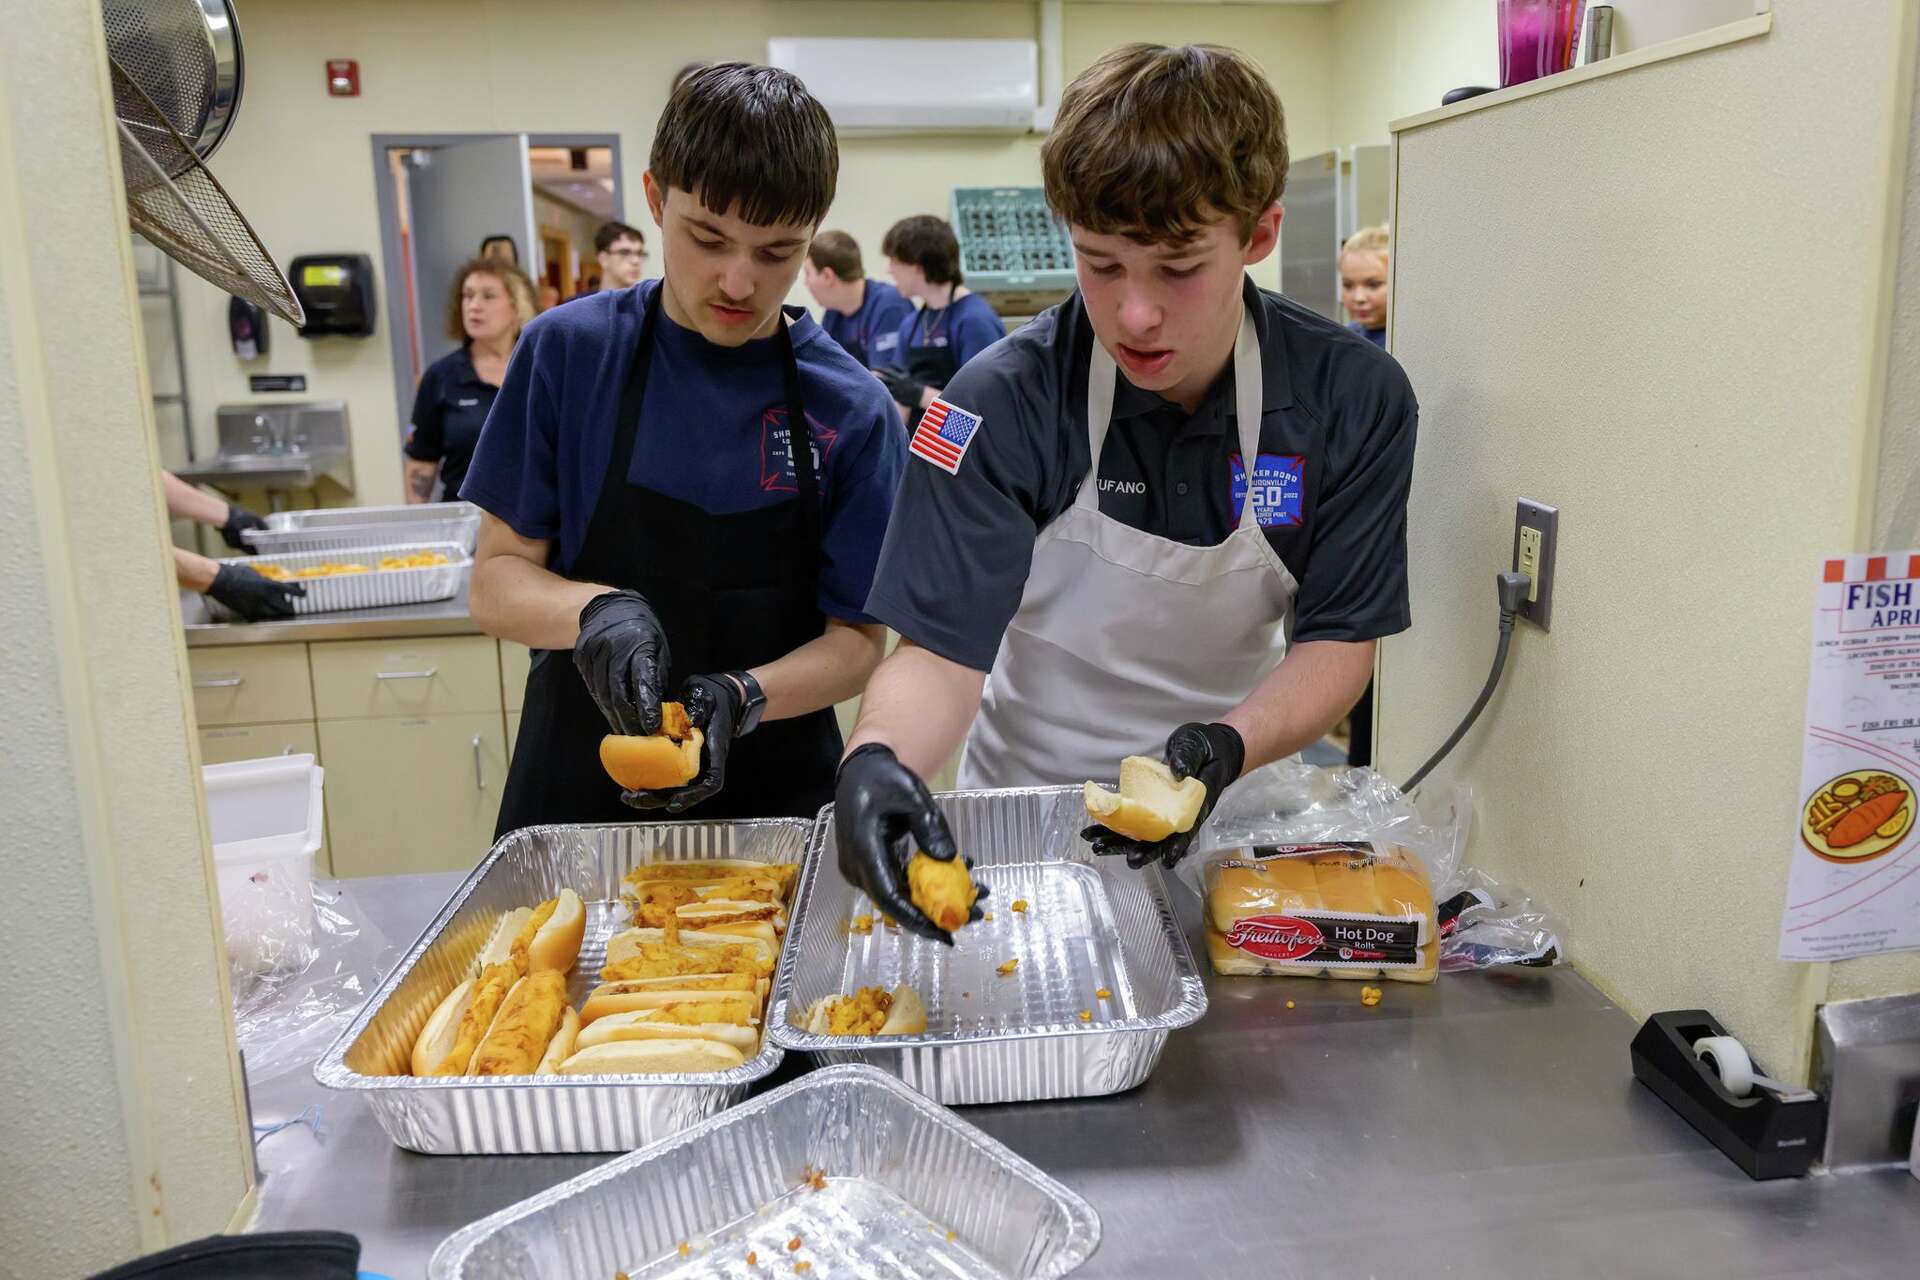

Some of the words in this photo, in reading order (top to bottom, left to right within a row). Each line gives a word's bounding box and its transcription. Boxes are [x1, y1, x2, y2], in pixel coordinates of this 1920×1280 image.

[1235, 470, 1270, 482] SHKER
[1097, 479, 1146, 494] UFANO
[1252, 486, 1281, 507] 50
[1847, 583, 1912, 610] FISH
[1870, 609, 1920, 628] APRI
[1226, 921, 1326, 952] Freihofer's
[1335, 926, 1363, 941] Hot
[1366, 928, 1395, 943] Dog
[1354, 941, 1376, 949] Rolls
